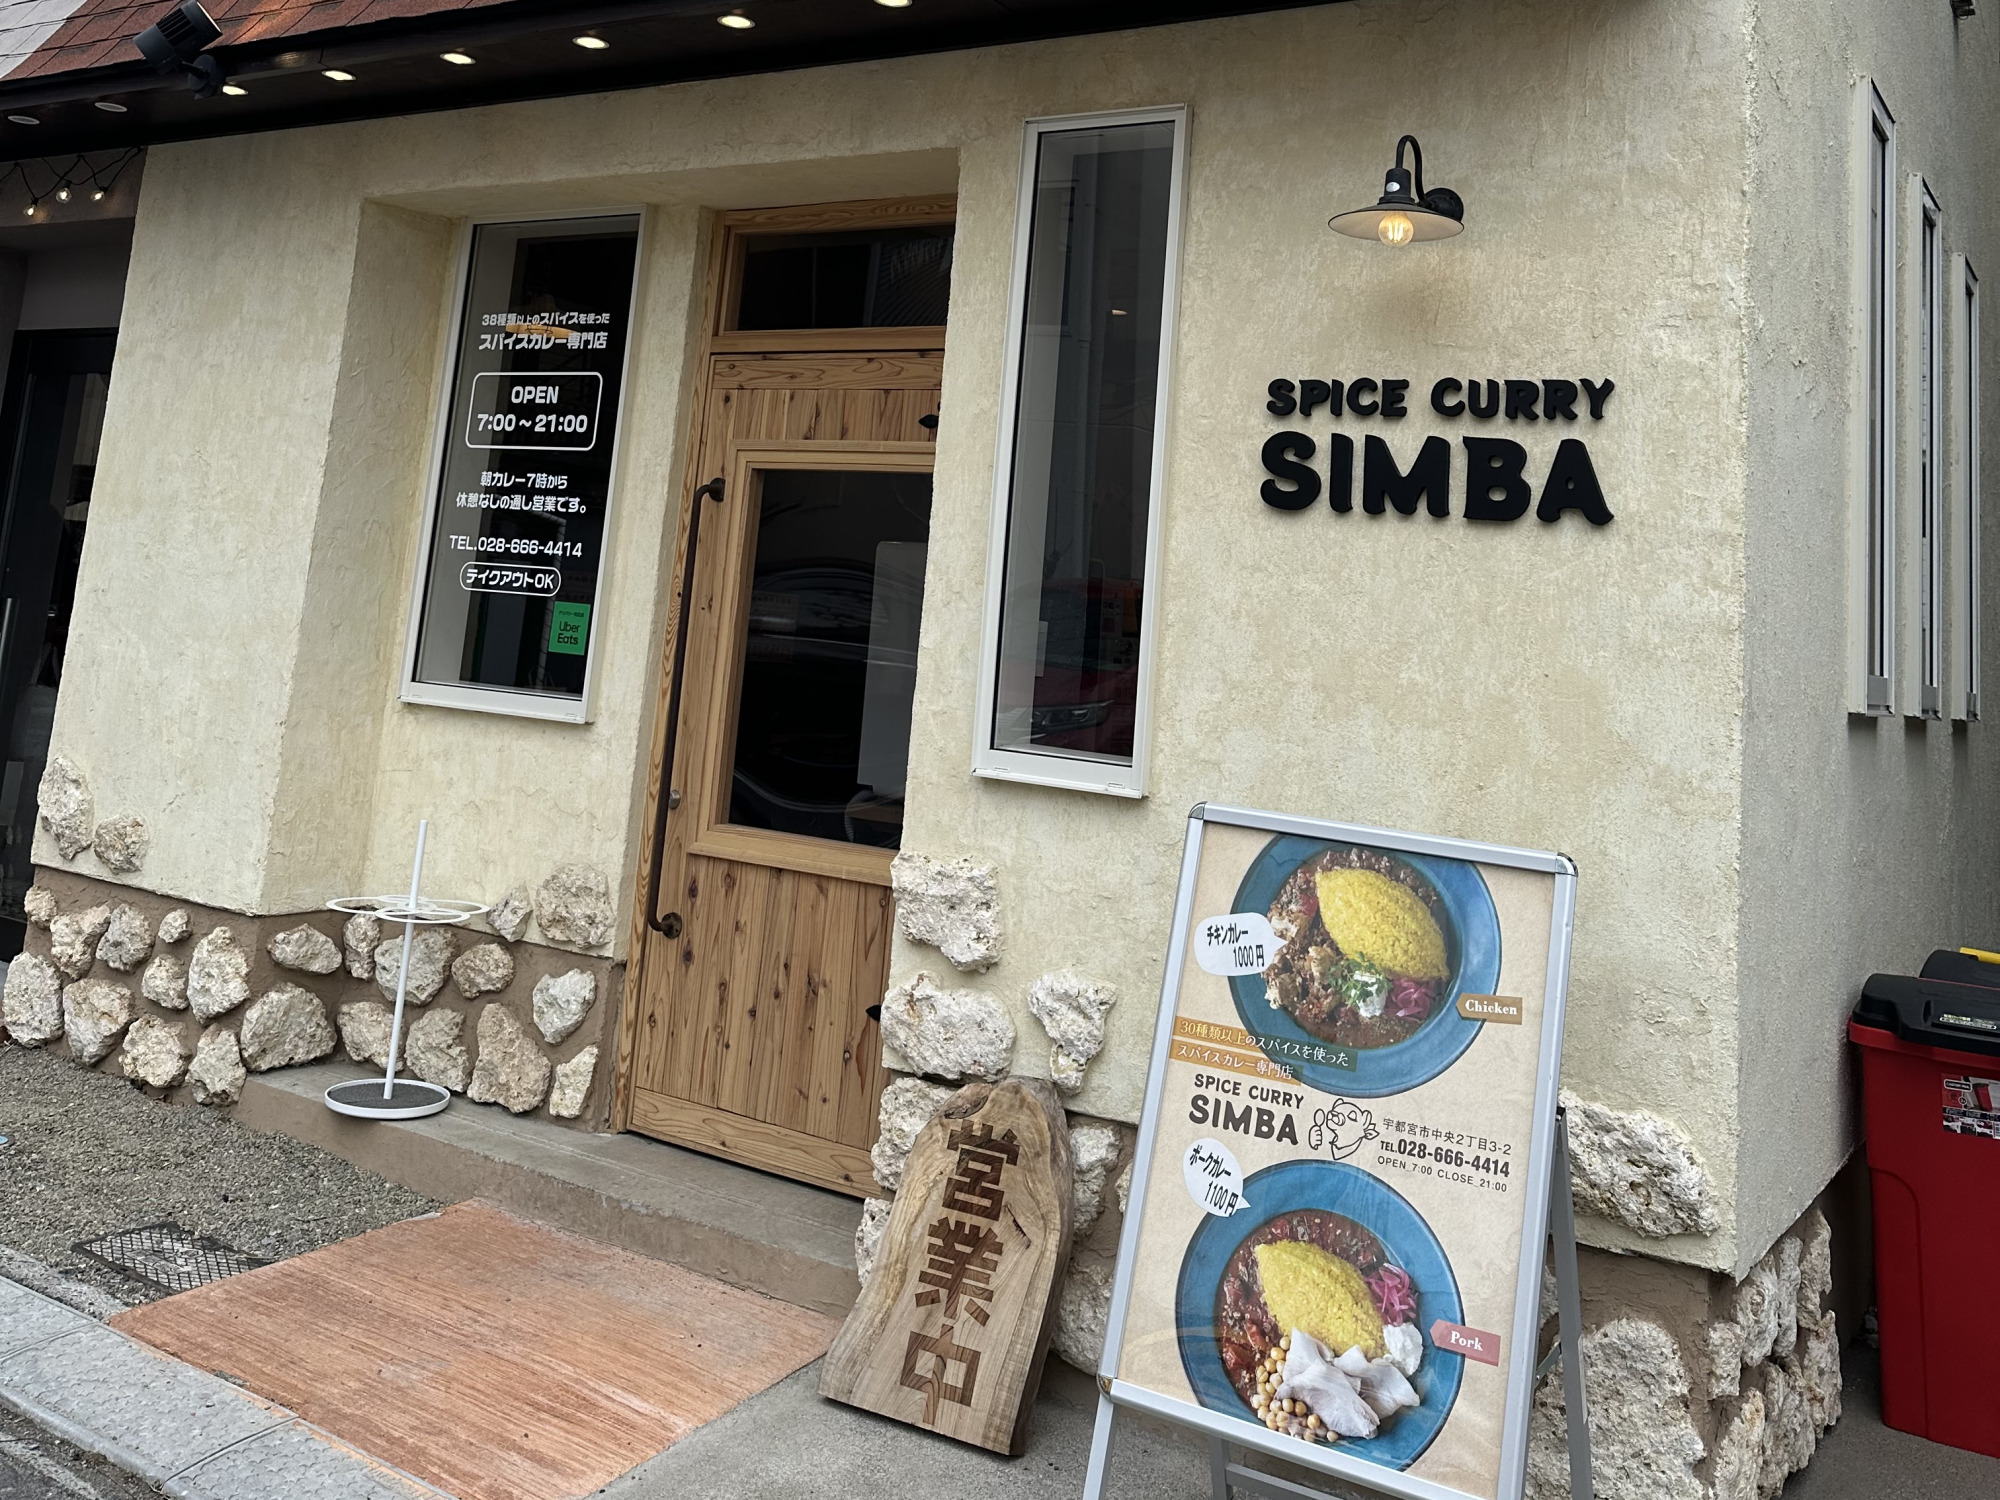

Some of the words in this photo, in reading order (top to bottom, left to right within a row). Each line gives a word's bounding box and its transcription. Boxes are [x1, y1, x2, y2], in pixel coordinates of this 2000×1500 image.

[482, 312, 610, 326] 38種類以上のスパイスを使った
[479, 332, 608, 350] スパイスカレー専門店
[511, 386, 559, 404] OPEN
[1266, 378, 1410, 418] SPICE
[1430, 377, 1615, 420] CURRY
[480, 471, 568, 489] 朝カレー7時から
[1260, 431, 1615, 525] SIMBA
[456, 492, 587, 514] 休憩なしの通し営業です。
[449, 535, 583, 558] TEL.028-666-4414
[466, 568, 555, 589] テイクアウトOK
[557, 633, 579, 645] Eats
[559, 621, 581, 633] Uber
[1206, 922, 1249, 947] チキンカレー
[1233, 944, 1265, 968] 1000円
[1465, 999, 1518, 1016] Chicken
[1180, 1020, 1349, 1067] 30種類以上のスパイスを使った
[1177, 1045, 1294, 1080] スパイスカレー専門店
[1194, 1073, 1242, 1096] SPICE
[1249, 1085, 1304, 1109] CURRY
[1189, 1094, 1299, 1146] SIMBA
[1382, 1118, 1512, 1156] 宇都宮市中央2丁目3-2
[1189, 1144, 1232, 1179] ポークカレー
[1380, 1138, 1510, 1178] TEL.028-666-4414
[1204, 1181, 1239, 1217] 1100円
[900, 1119, 1021, 1426] 営業中
[1450, 1330, 1483, 1352] Pork
